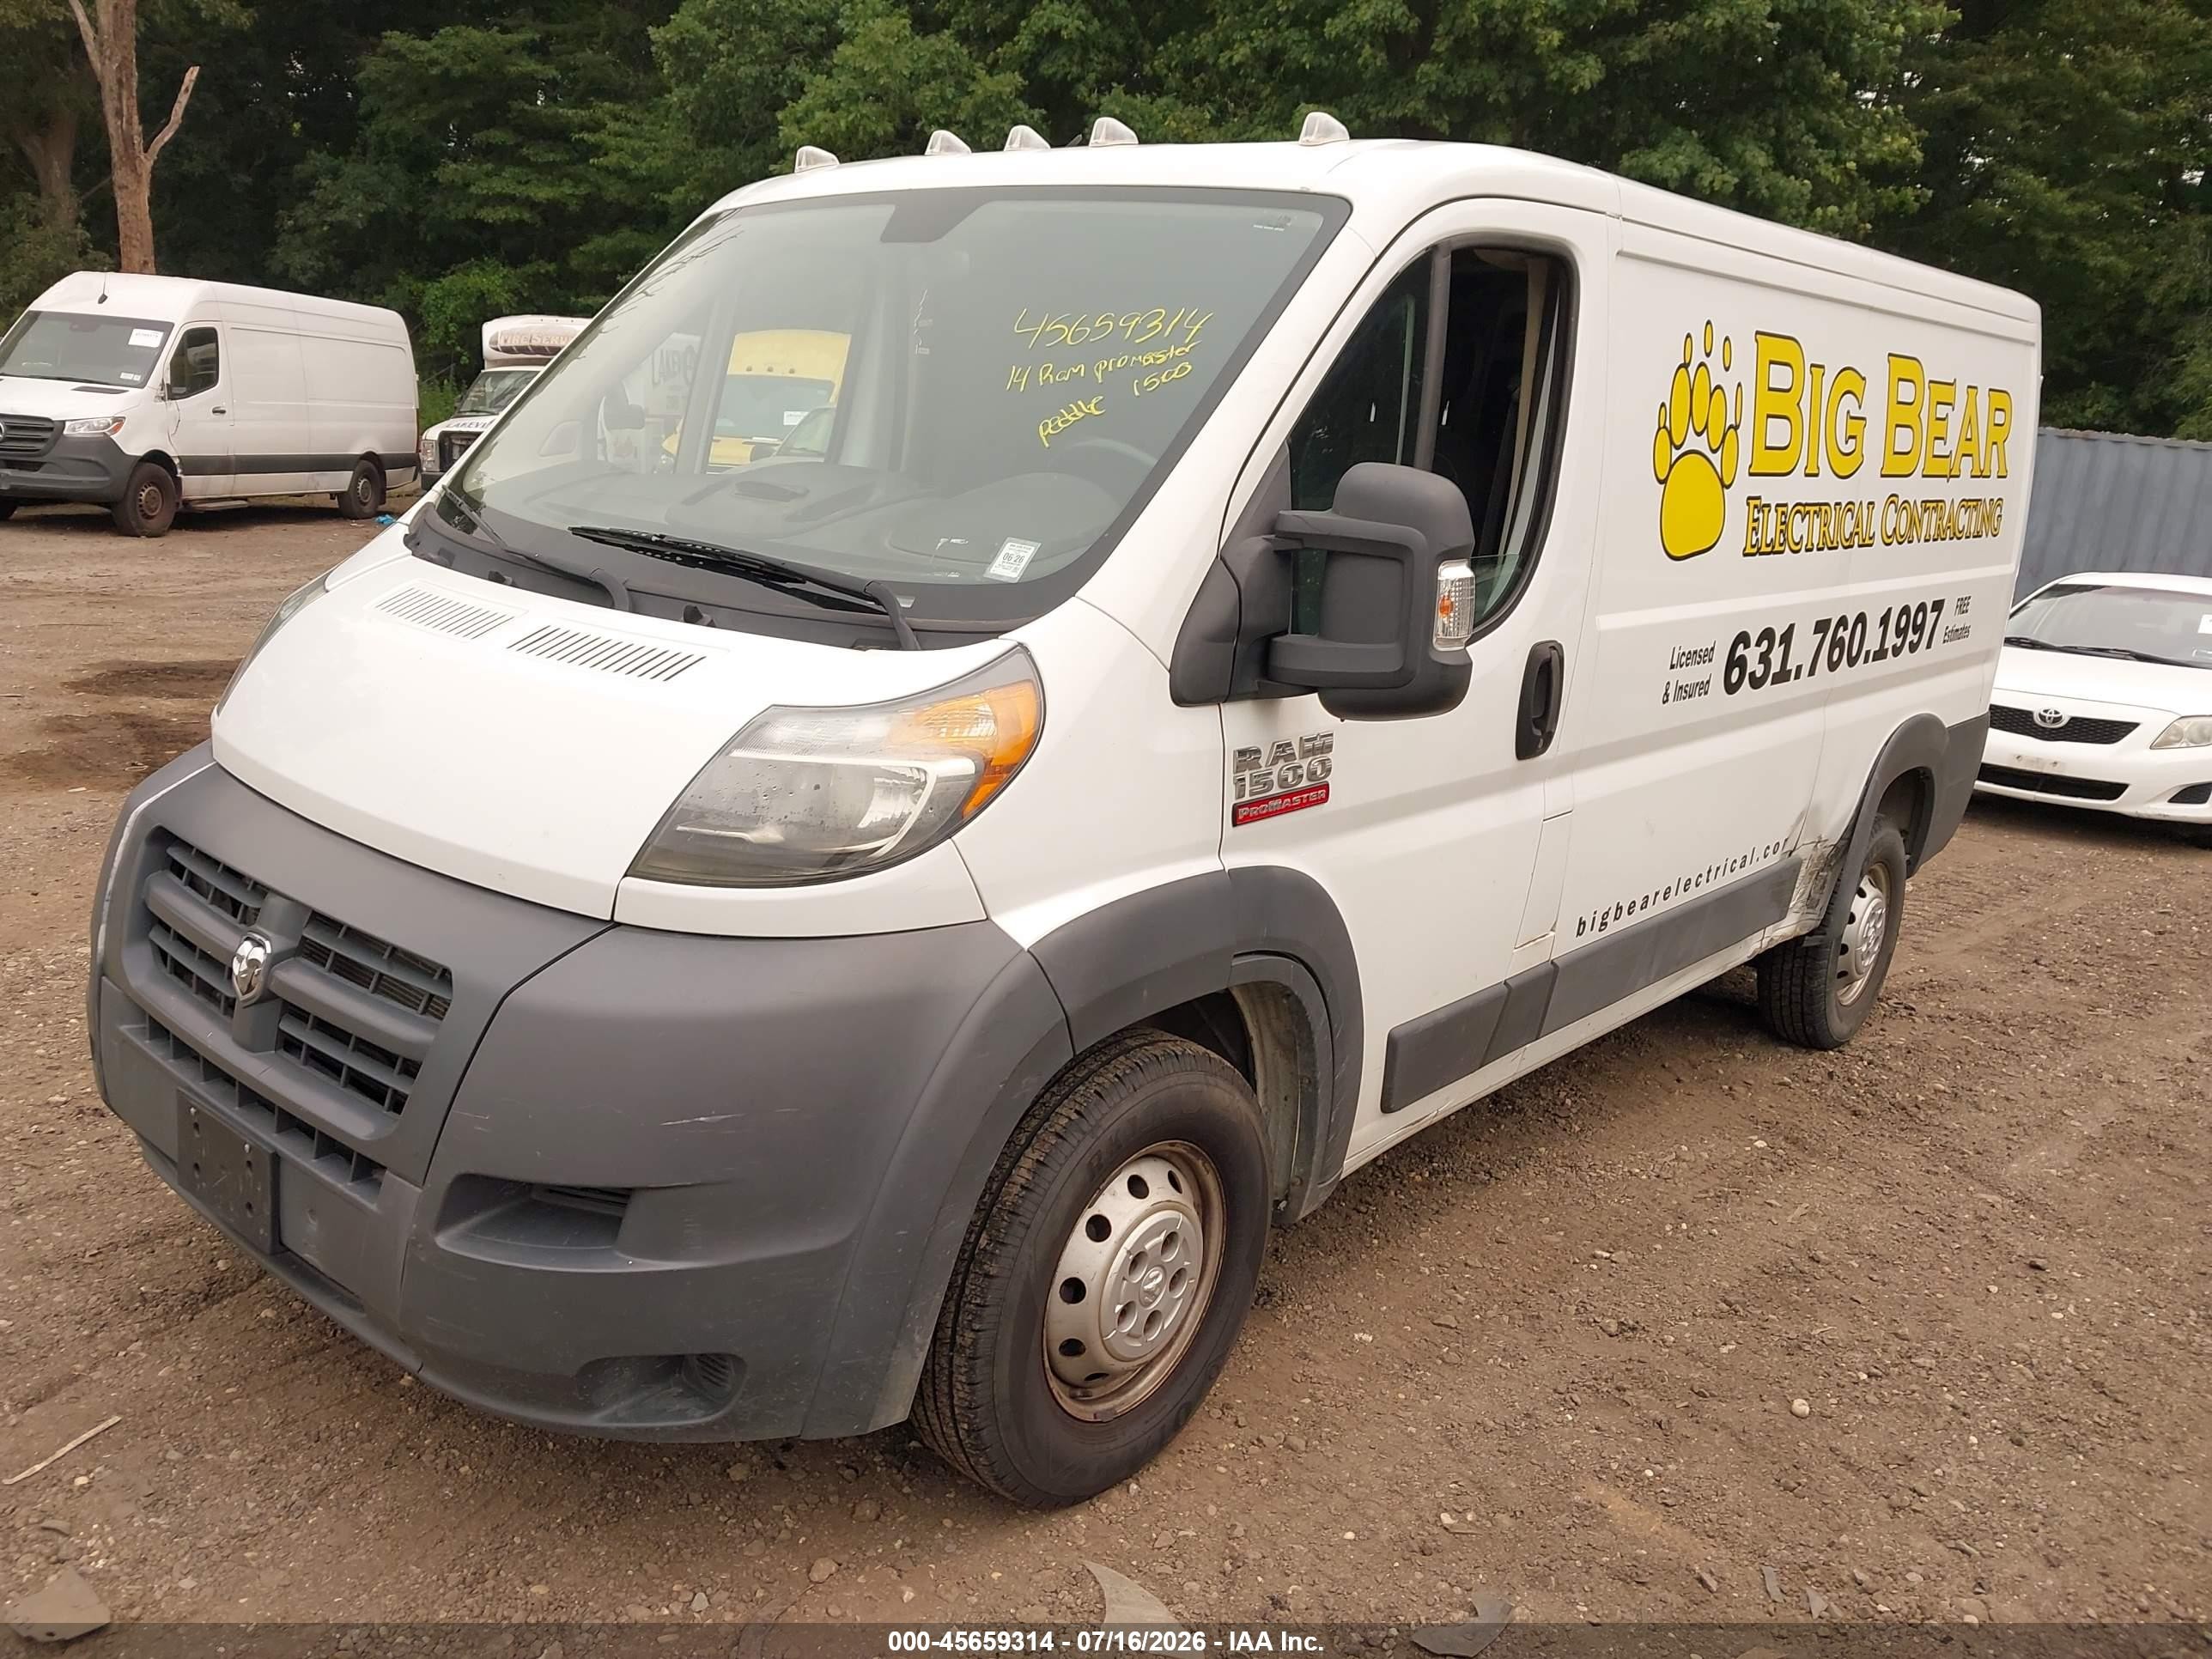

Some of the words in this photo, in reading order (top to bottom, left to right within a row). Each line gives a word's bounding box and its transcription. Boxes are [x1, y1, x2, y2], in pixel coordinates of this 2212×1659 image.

[1014, 308, 1213, 349] 45659314
[1006, 365, 1031, 392] 14
[1039, 363, 1085, 386] Ram
[1094, 340, 1203, 383] promaster
[1133, 361, 1193, 396] 1500
[1748, 330, 1867, 479] BIG
[1880, 352, 2014, 483] BEAR
[1742, 495, 1875, 557] ELECTRICAL
[1881, 493, 2004, 546] CONTRACTING
[1954, 595, 1972, 617] FREE
[1723, 598, 1946, 696] 631.760.1997
[1942, 622, 1972, 645] Estimates
[1668, 639, 1716, 671] Licensed
[1662, 680, 1671, 705] &
[1672, 672, 1711, 702] Insured
[1233, 730, 1334, 774] RAM
[1233, 756, 1333, 800] 1500
